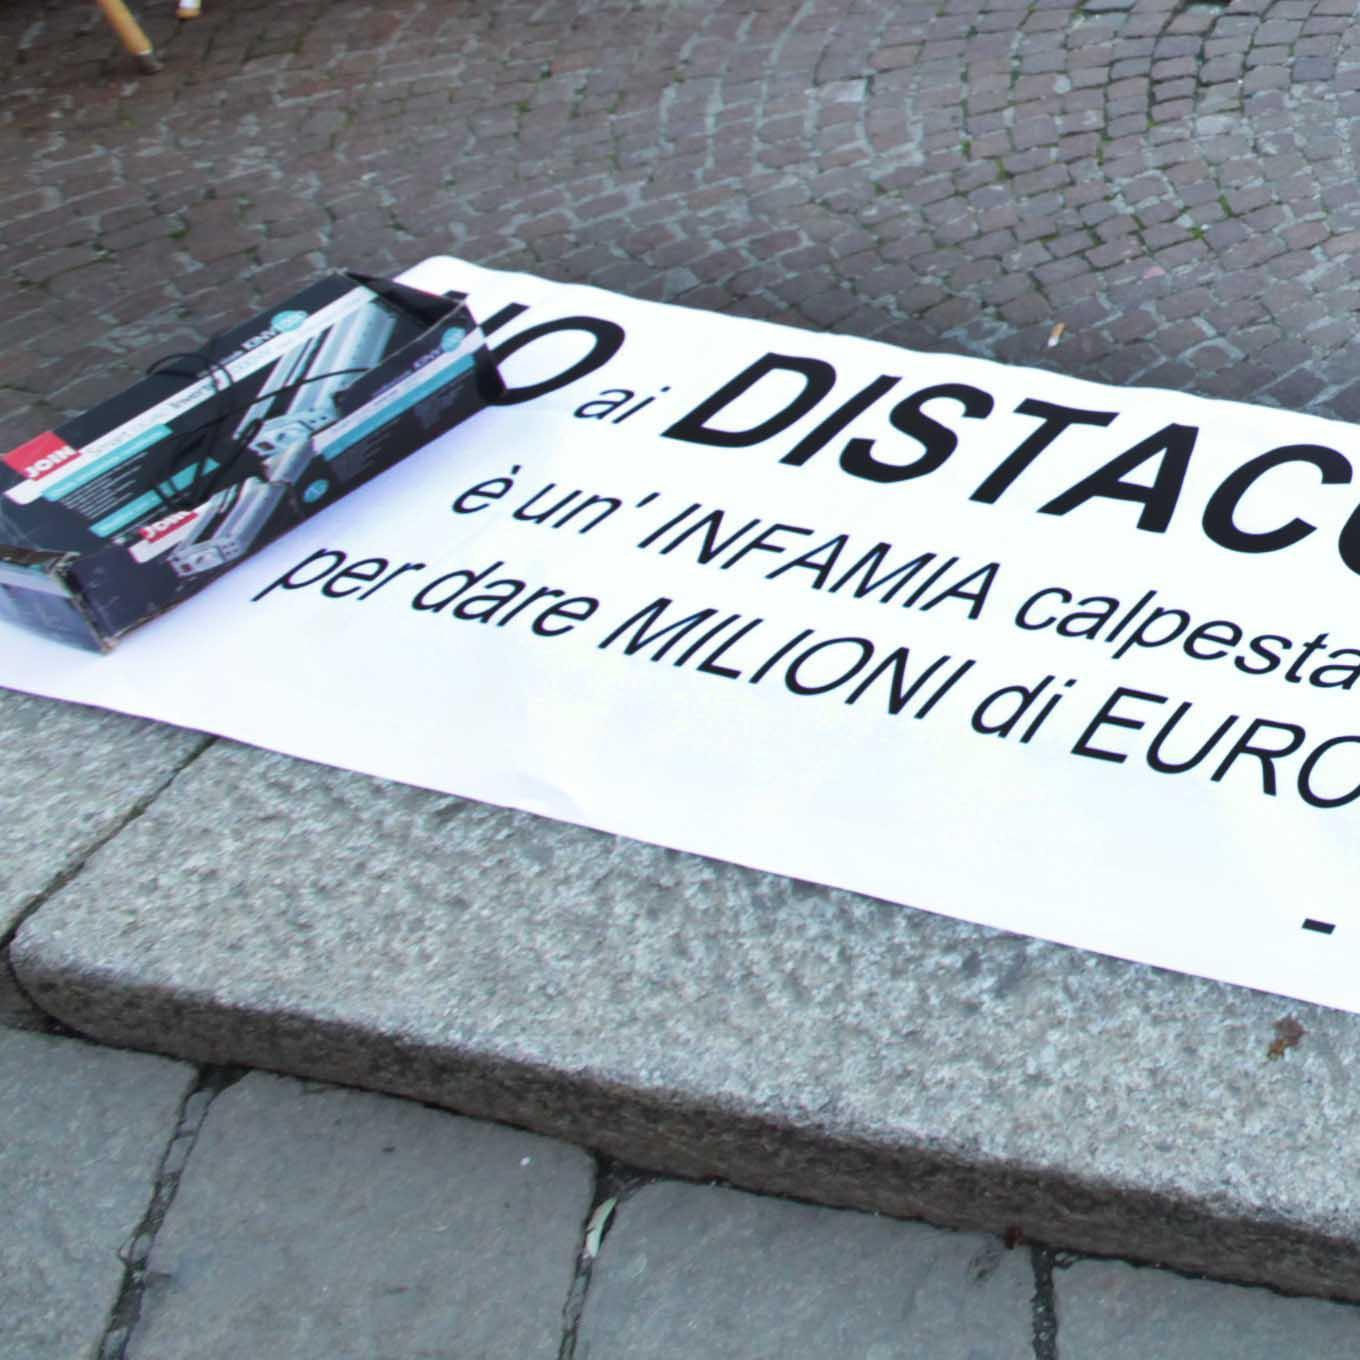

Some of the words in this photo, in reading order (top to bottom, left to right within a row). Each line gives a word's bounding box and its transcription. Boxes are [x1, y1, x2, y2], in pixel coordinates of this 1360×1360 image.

[573, 385, 671, 425] ai
[452, 463, 522, 515] è
[512, 483, 661, 534] un'
[636, 502, 1001, 620] INFAMIA
[251, 548, 427, 602] per
[411, 560, 600, 637] dare
[597, 597, 977, 720] MILIONI
[971, 673, 1075, 744] di
